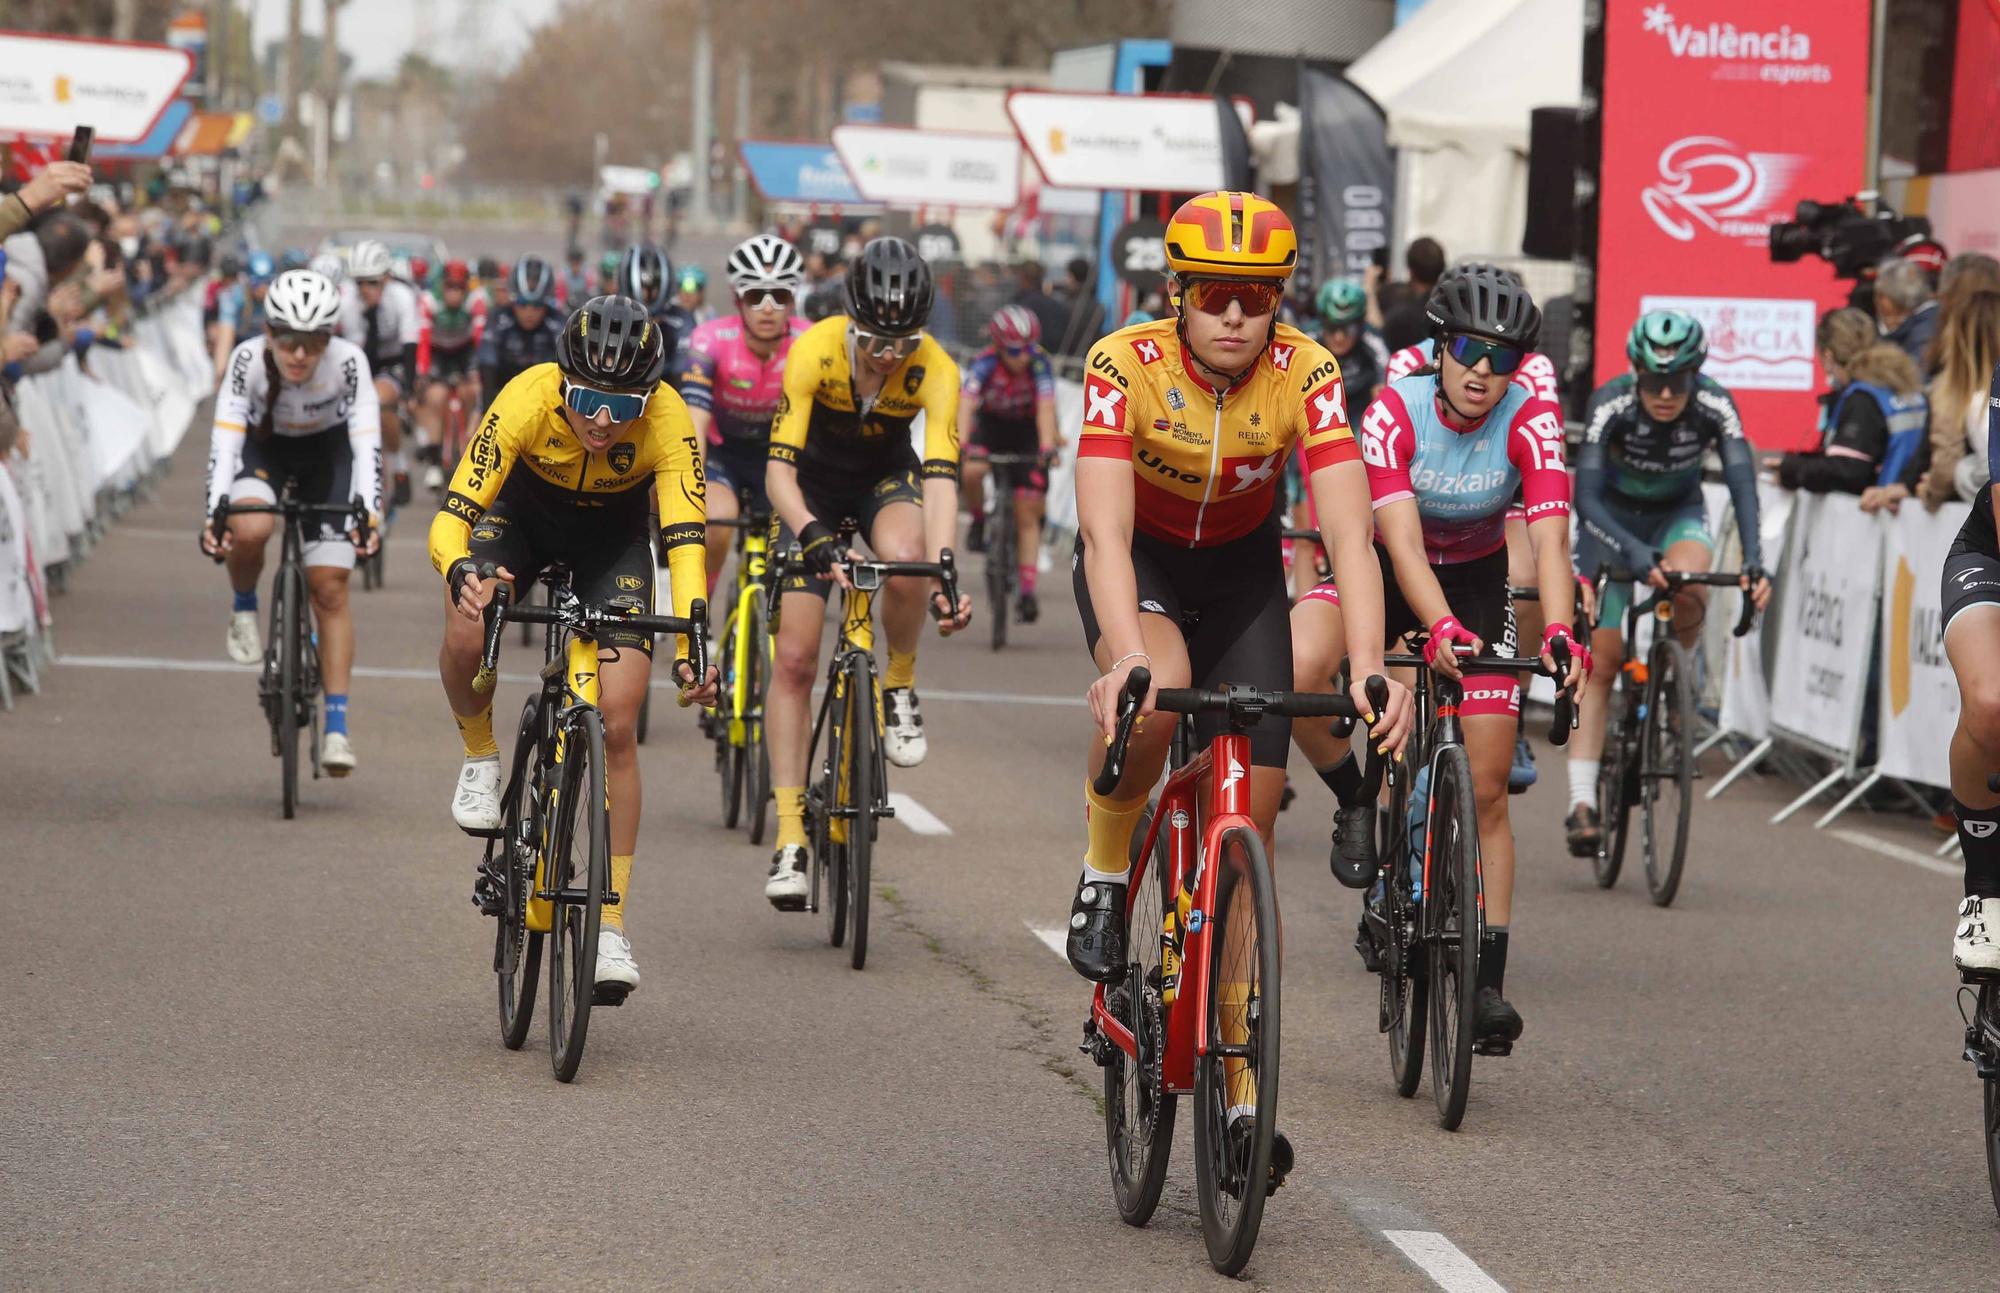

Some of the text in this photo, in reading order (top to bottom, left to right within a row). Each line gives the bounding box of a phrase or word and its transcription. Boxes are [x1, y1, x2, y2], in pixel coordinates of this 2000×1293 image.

[1667, 23, 1810, 60] València
[232, 349, 253, 397] FARTO
[1092, 351, 1129, 389] Uno
[468, 412, 500, 492] SARRION
[1171, 433, 1211, 446] WORLDTEAM
[1173, 427, 1203, 440] WOMEN'S
[1361, 400, 1395, 469] BH
[1526, 411, 1567, 473] BH
[1137, 448, 1202, 485] Uno
[1416, 466, 1506, 496] Bizkaia
